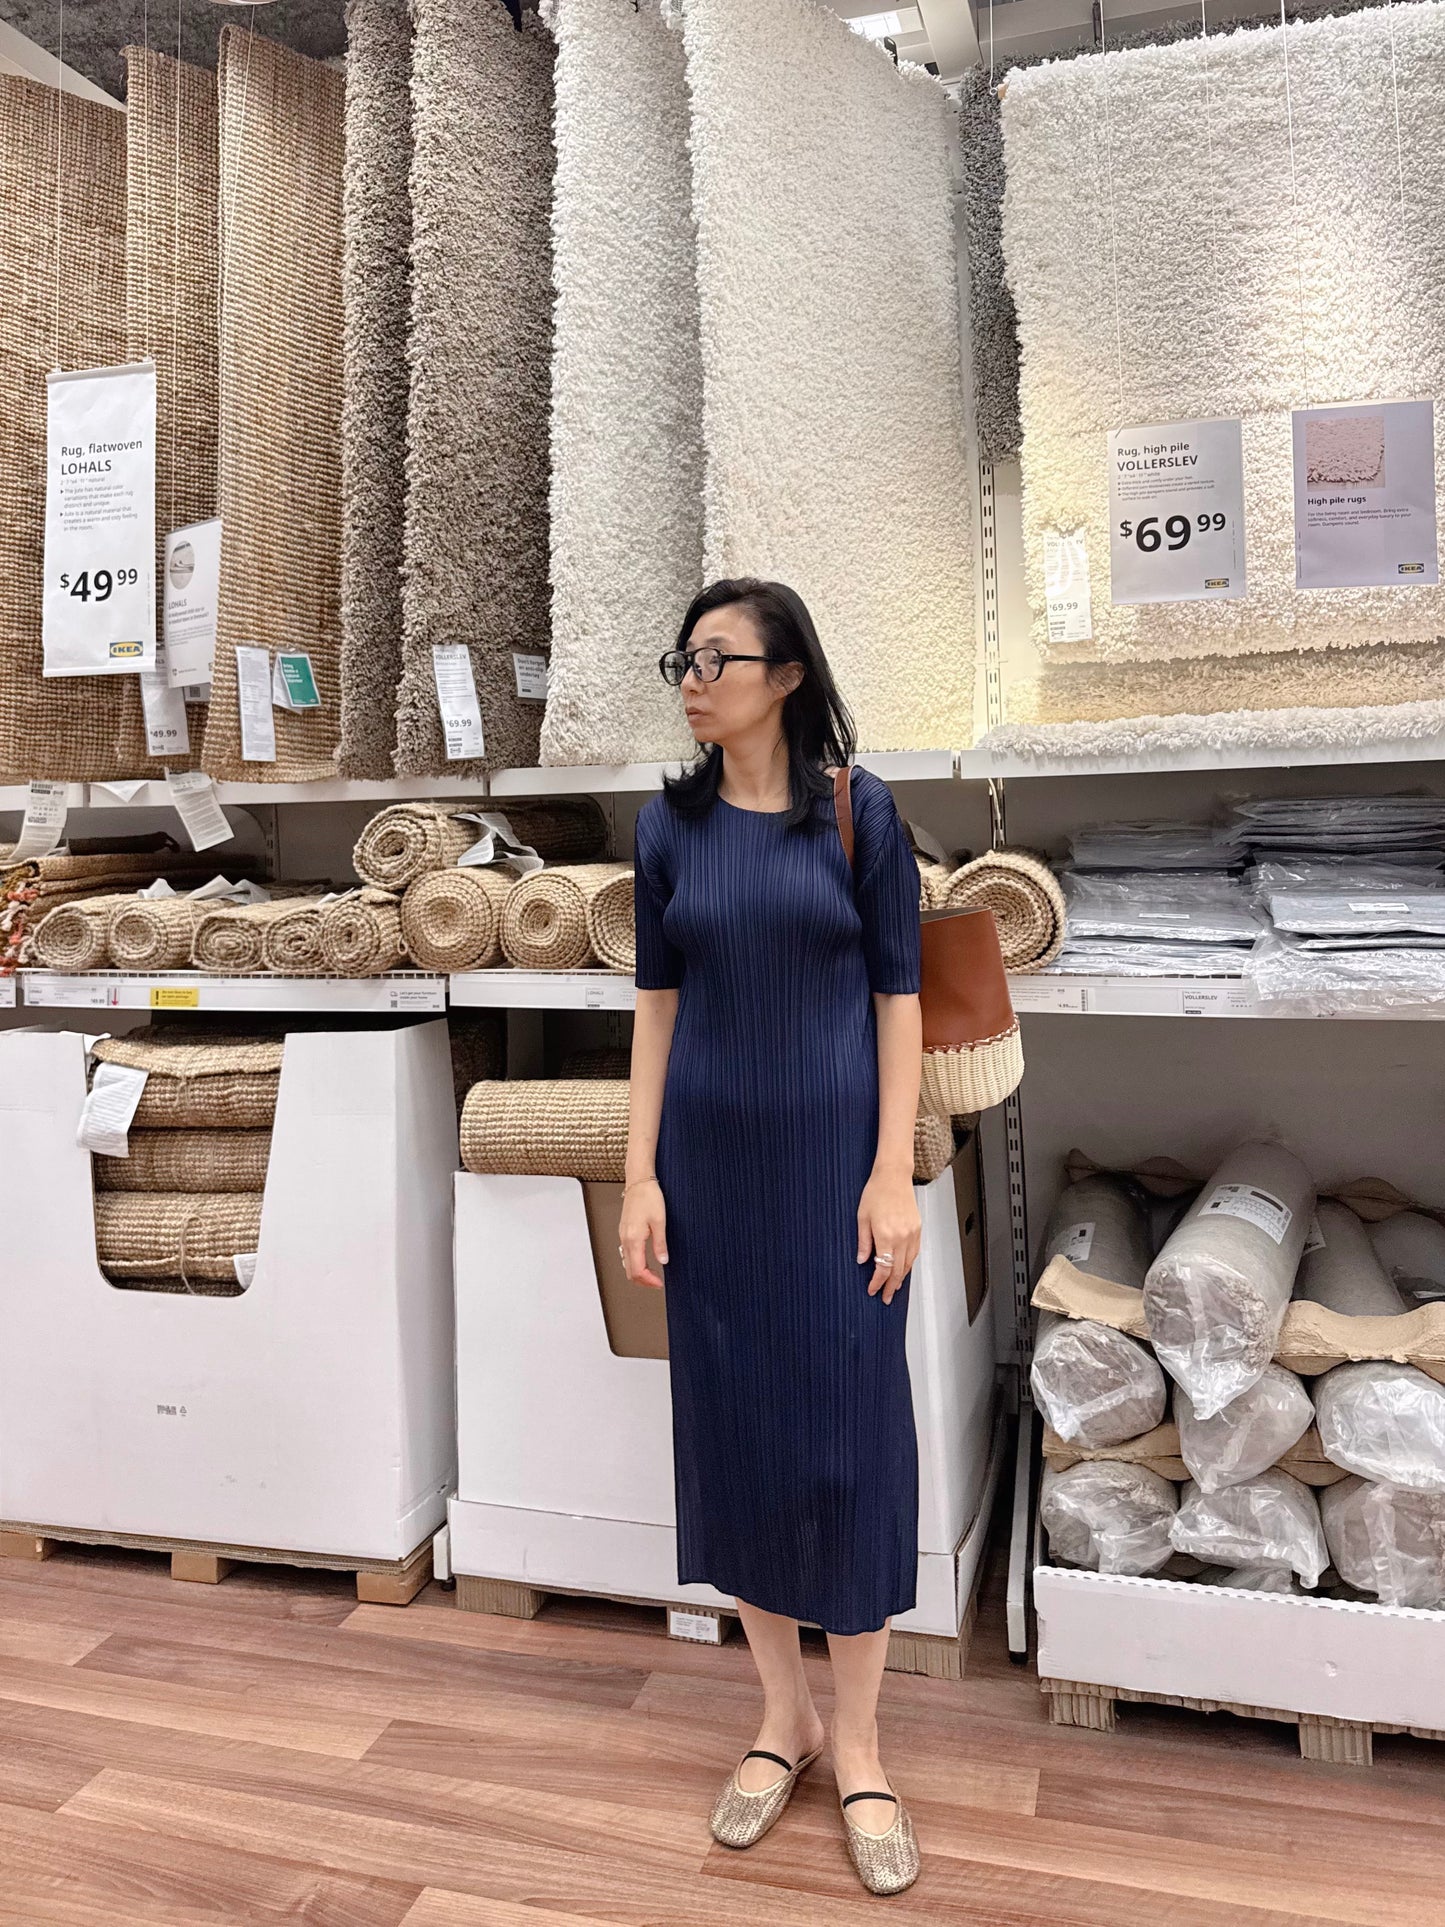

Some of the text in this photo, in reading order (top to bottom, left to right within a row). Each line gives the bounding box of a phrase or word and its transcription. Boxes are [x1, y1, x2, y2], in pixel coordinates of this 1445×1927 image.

[62, 440, 143, 458] Rug, flatwoven
[1118, 442, 1189, 457] Rug, high pile
[61, 460, 112, 475] LOHALS
[1117, 455, 1198, 471] VOLLERSLEV
[1308, 496, 1366, 506] High pile rugs
